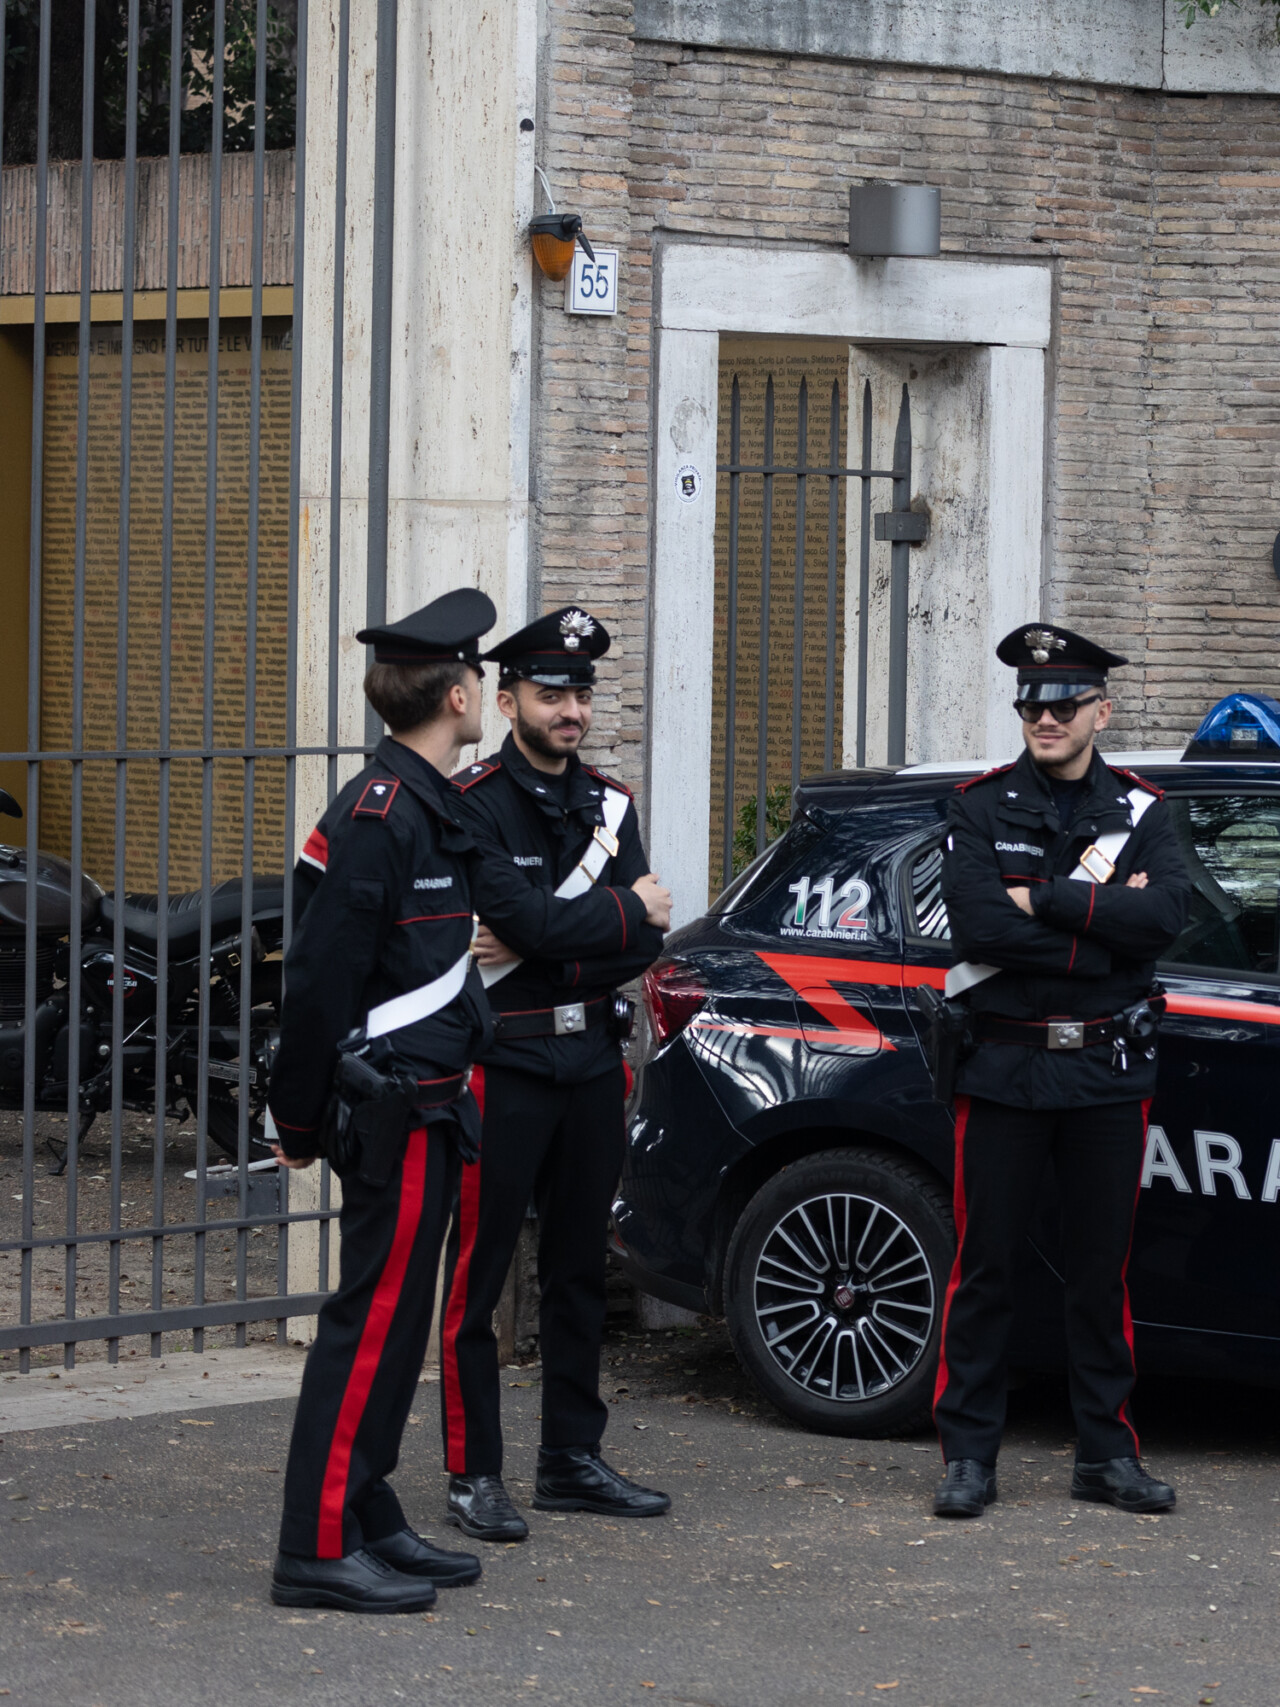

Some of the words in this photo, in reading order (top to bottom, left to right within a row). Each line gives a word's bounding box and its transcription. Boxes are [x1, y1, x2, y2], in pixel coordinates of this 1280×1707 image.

[581, 264, 608, 298] 55
[187, 336, 223, 353] TUTE
[227, 335, 241, 352] LE
[788, 876, 872, 930] 112
[780, 927, 868, 941] www.carabinieri.it
